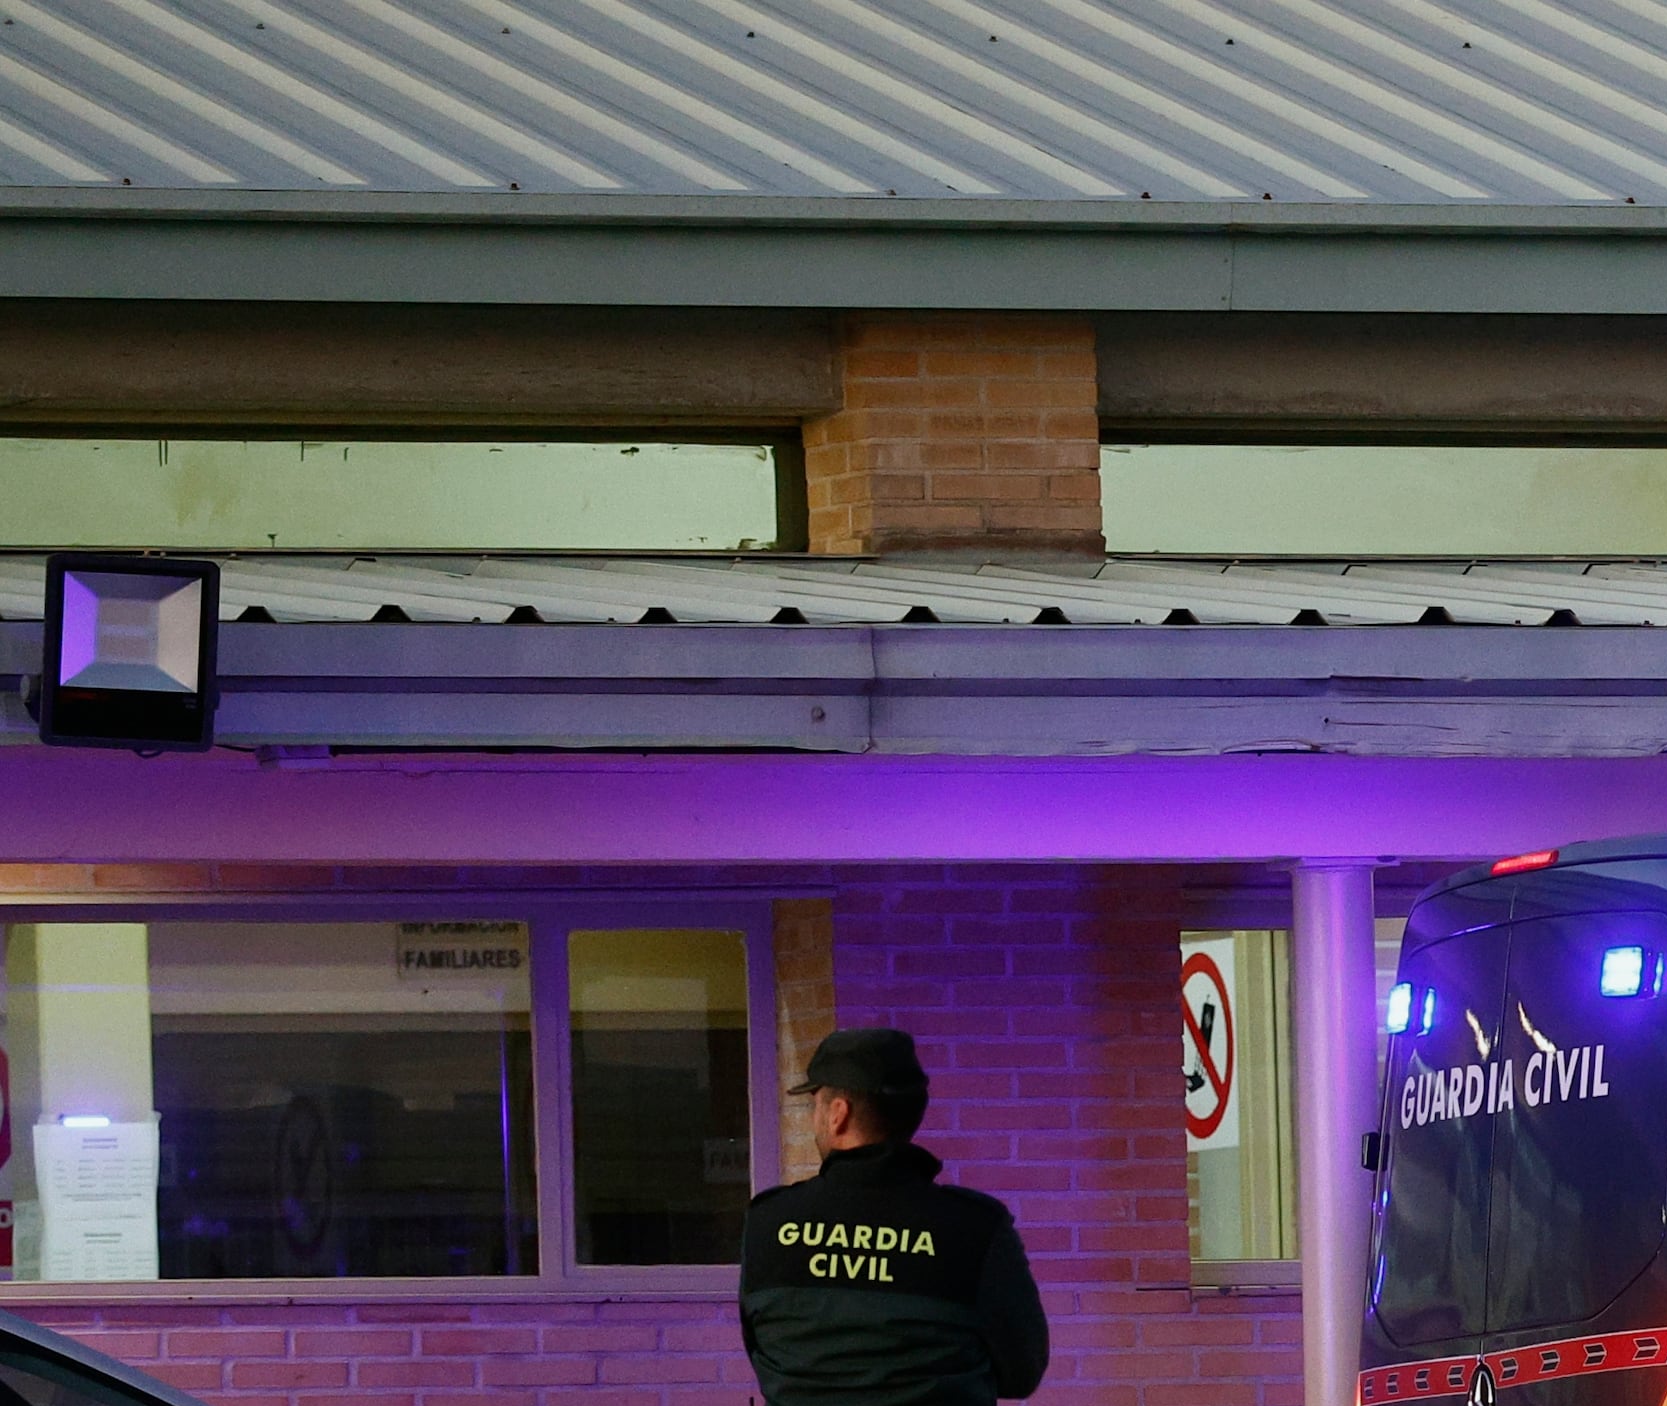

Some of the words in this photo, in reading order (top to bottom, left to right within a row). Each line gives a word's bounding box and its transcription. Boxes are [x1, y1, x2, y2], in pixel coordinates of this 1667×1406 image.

[405, 949, 520, 969] FAMILIARES
[1401, 1059, 1514, 1129] GUARDIA
[1524, 1045, 1609, 1107] CIVIL
[778, 1222, 935, 1256] GUARDIA
[809, 1253, 893, 1282] CIVIL
